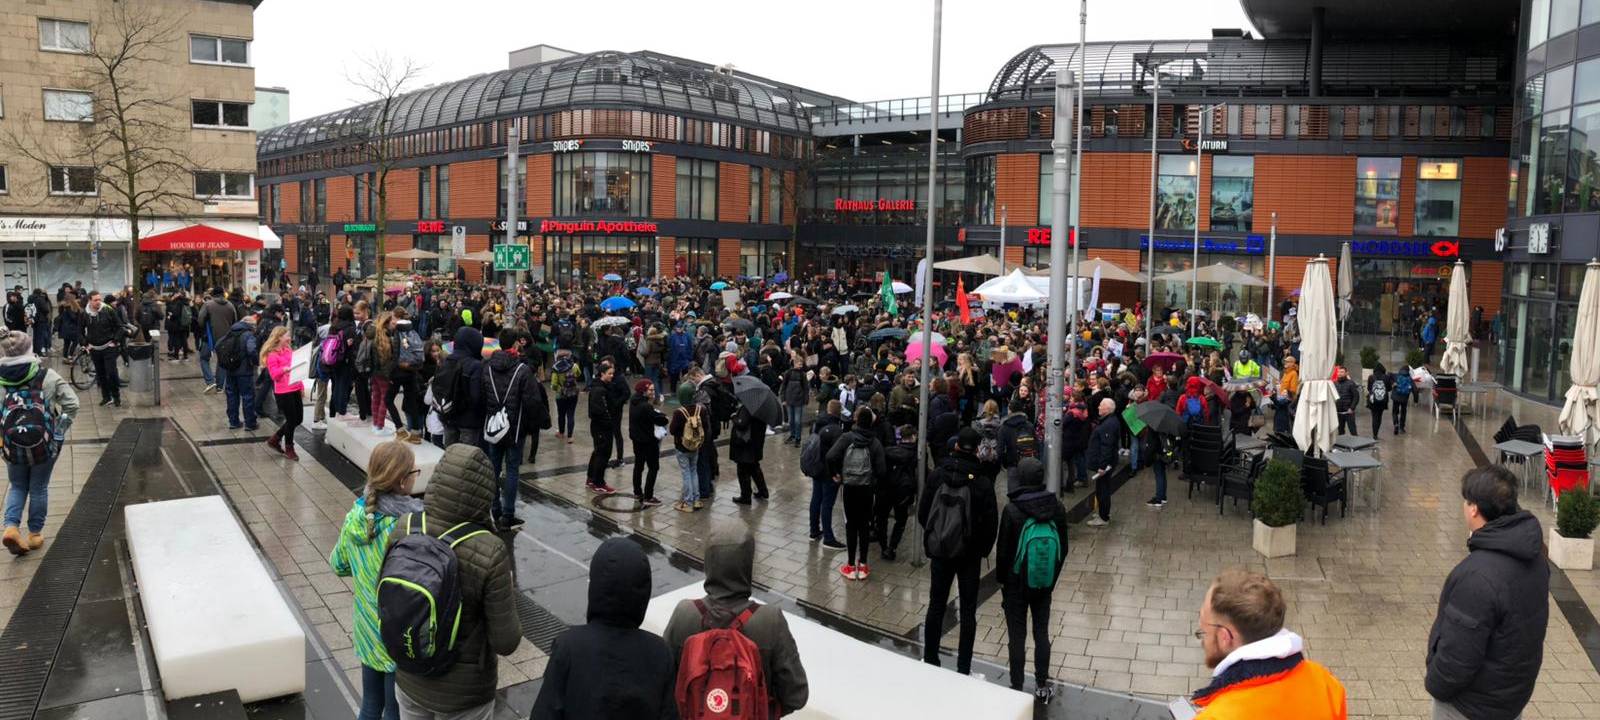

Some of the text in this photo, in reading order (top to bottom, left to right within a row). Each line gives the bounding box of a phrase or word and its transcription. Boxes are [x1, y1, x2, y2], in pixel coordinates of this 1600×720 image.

[553, 140, 580, 152] snipes
[622, 140, 650, 152] snipes
[1197, 140, 1227, 150] ATURN
[834, 198, 914, 210] RATHAUS GALERIE
[9, 219, 46, 229] Moden
[549, 220, 594, 233] Pinguin
[596, 219, 657, 233] Apotheke
[207, 241, 230, 249] JEANS
